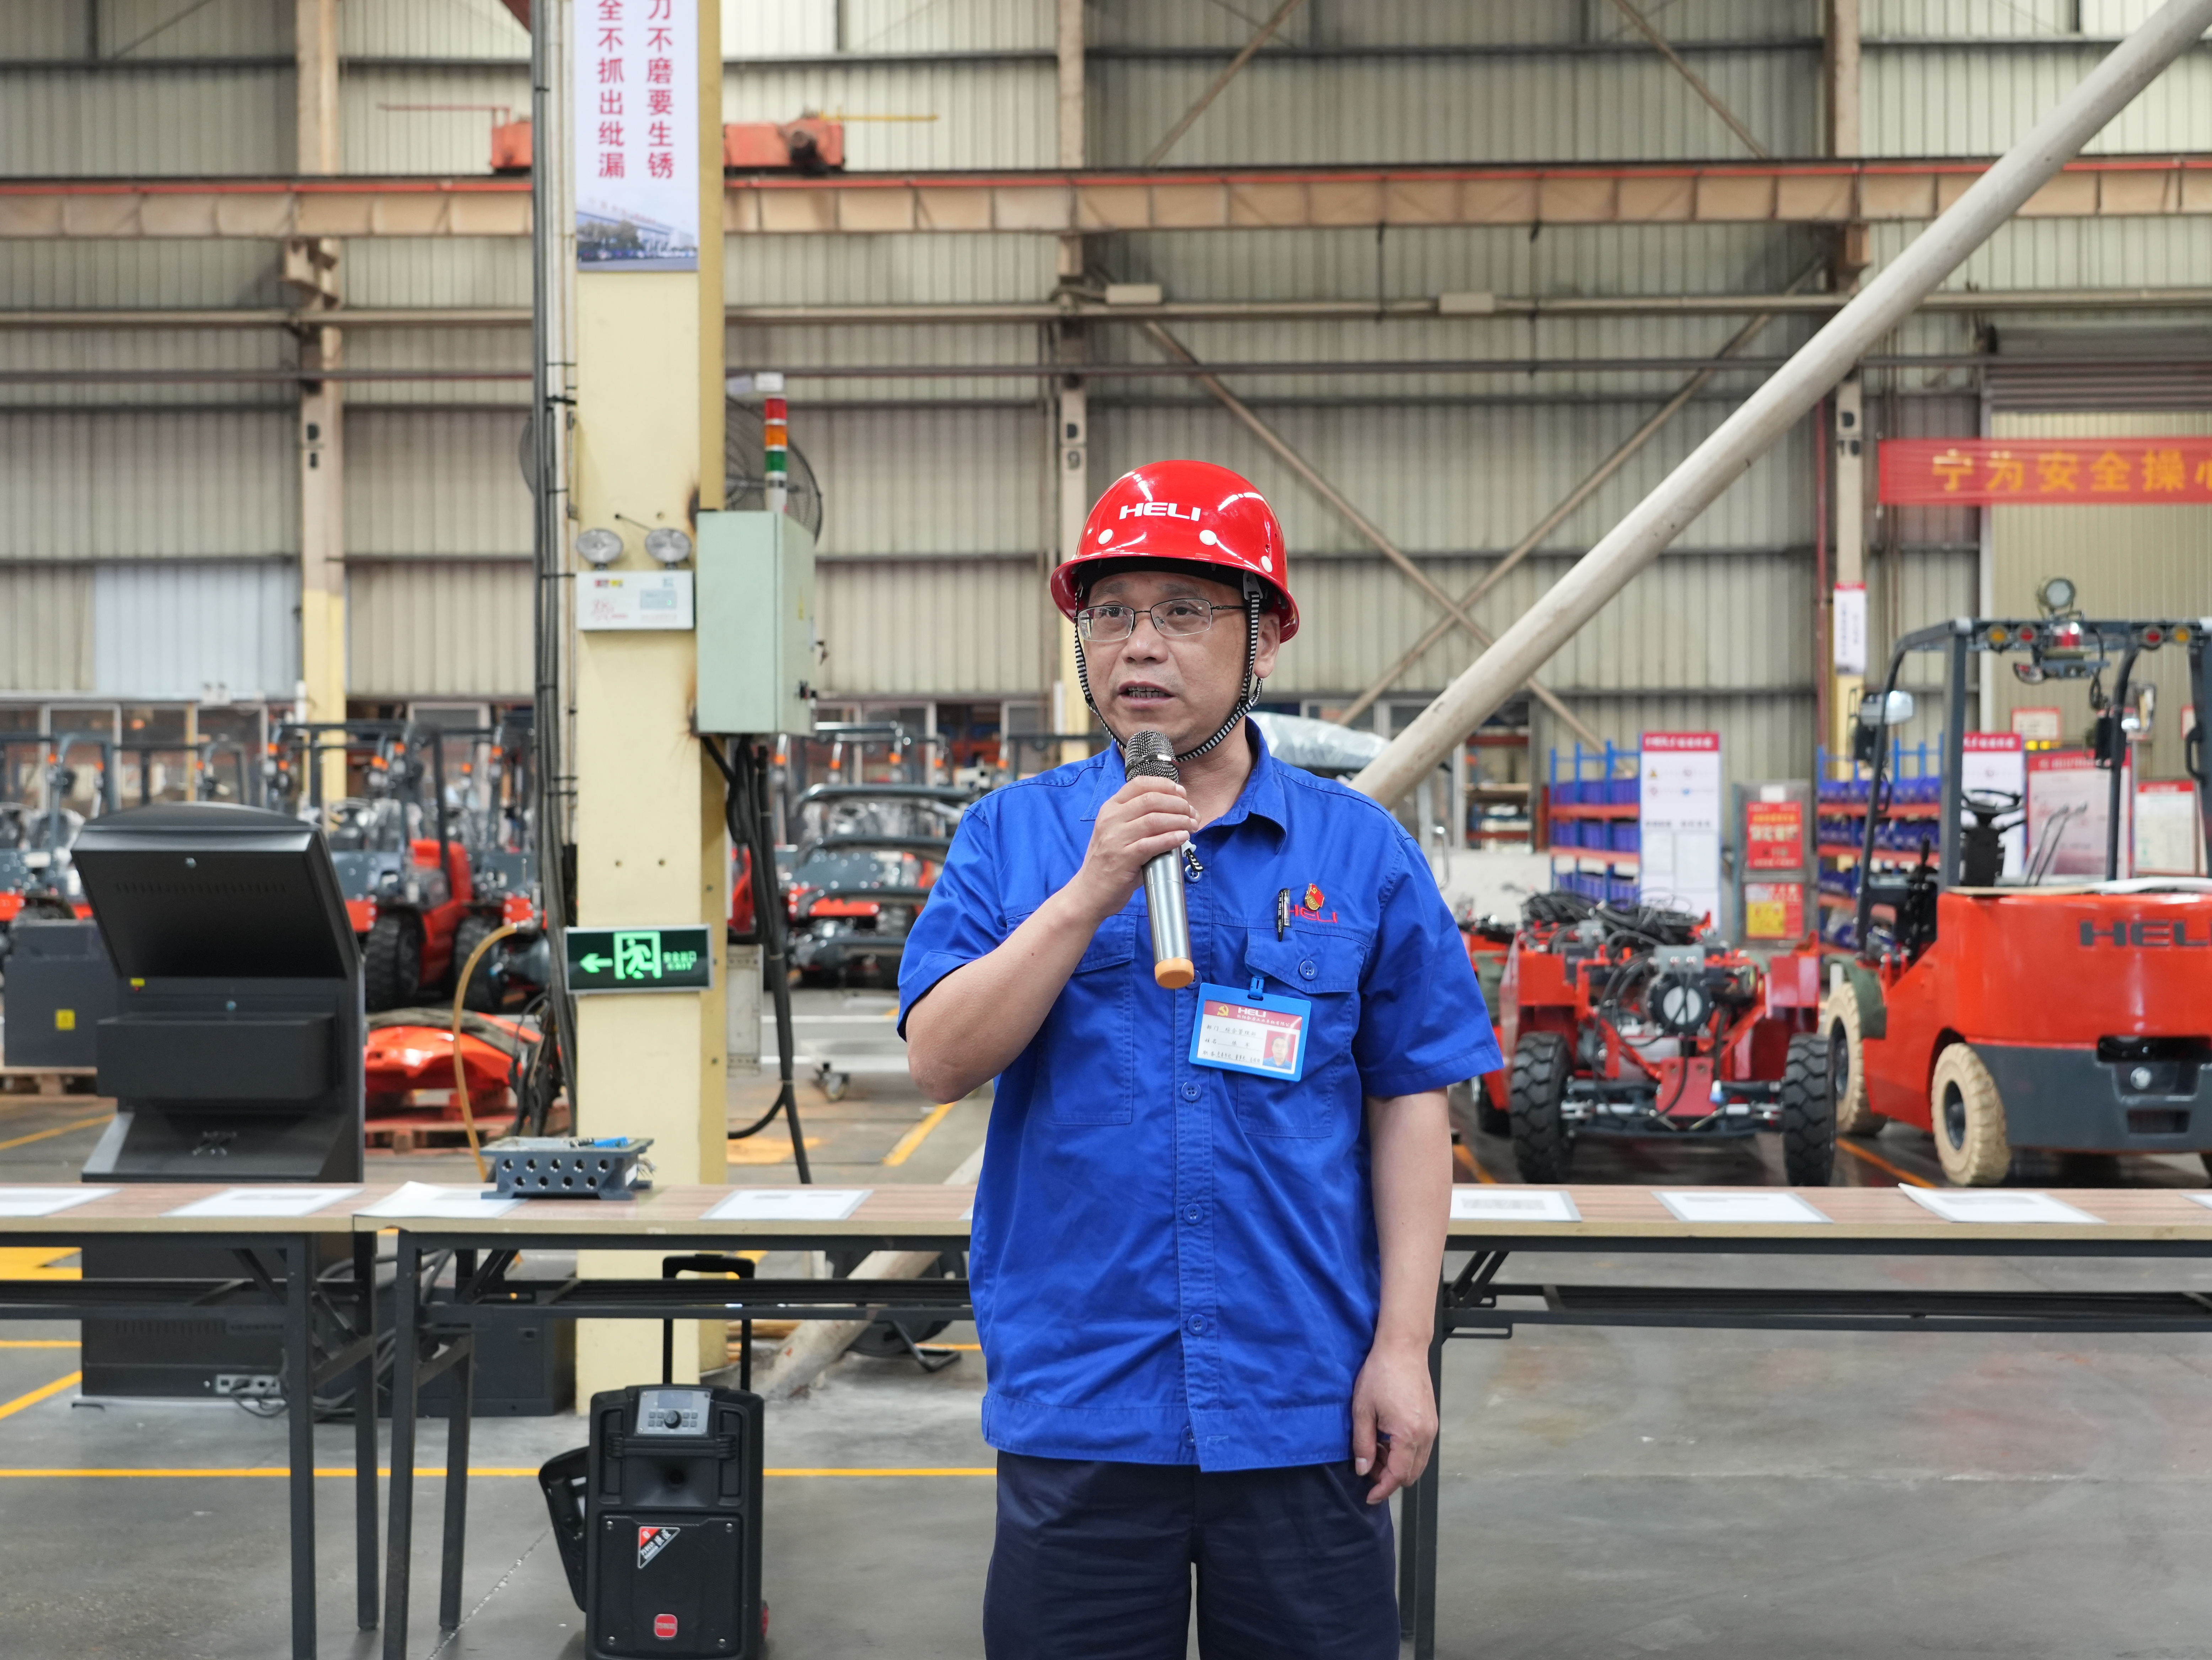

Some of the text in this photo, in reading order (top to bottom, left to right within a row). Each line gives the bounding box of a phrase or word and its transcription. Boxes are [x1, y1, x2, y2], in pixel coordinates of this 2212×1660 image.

[1119, 502, 1201, 521] HELI
[2079, 920, 2212, 947] HEL
[1238, 1007, 1266, 1018] HELI
